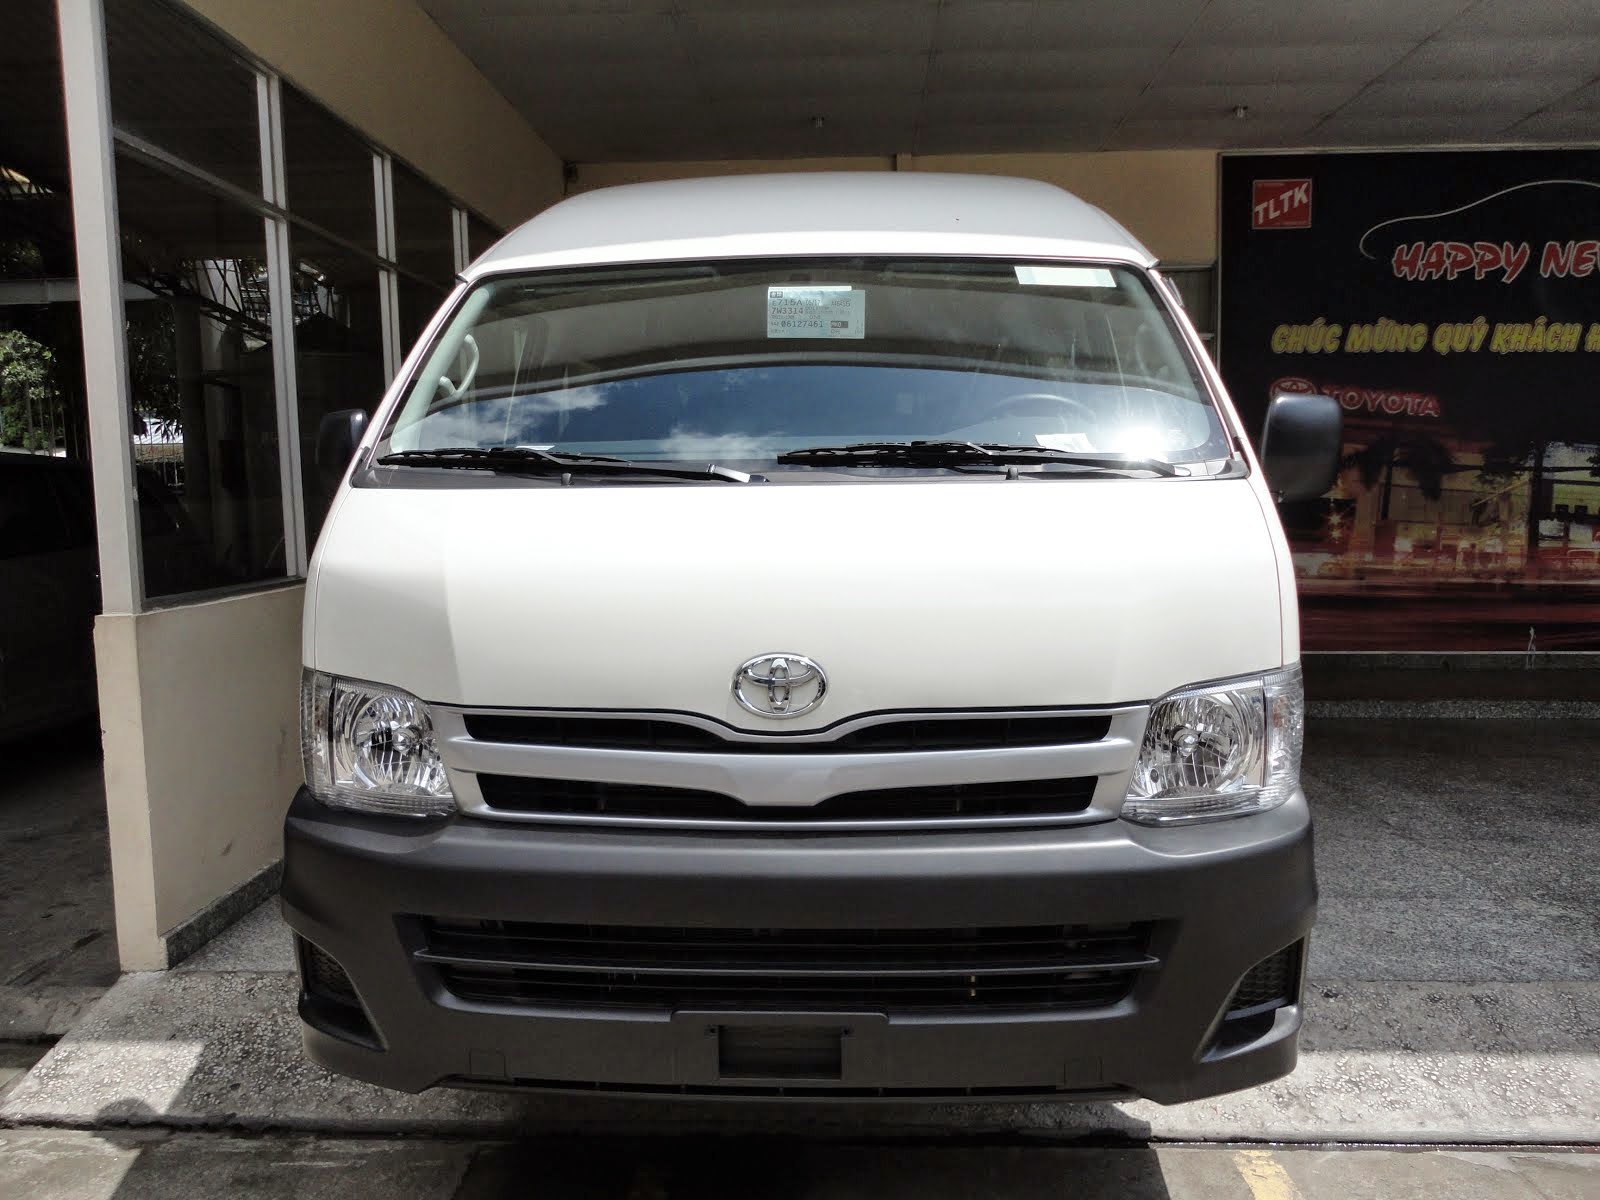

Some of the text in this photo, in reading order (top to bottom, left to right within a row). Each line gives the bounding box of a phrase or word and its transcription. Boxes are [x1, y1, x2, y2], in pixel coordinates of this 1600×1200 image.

[1254, 182, 1309, 225] TLTK
[1392, 240, 1600, 284] HAPPY NE
[1270, 316, 1342, 354] CHÚC
[1432, 315, 1489, 356] QUÝ
[1489, 315, 1582, 355] KHÁCH
